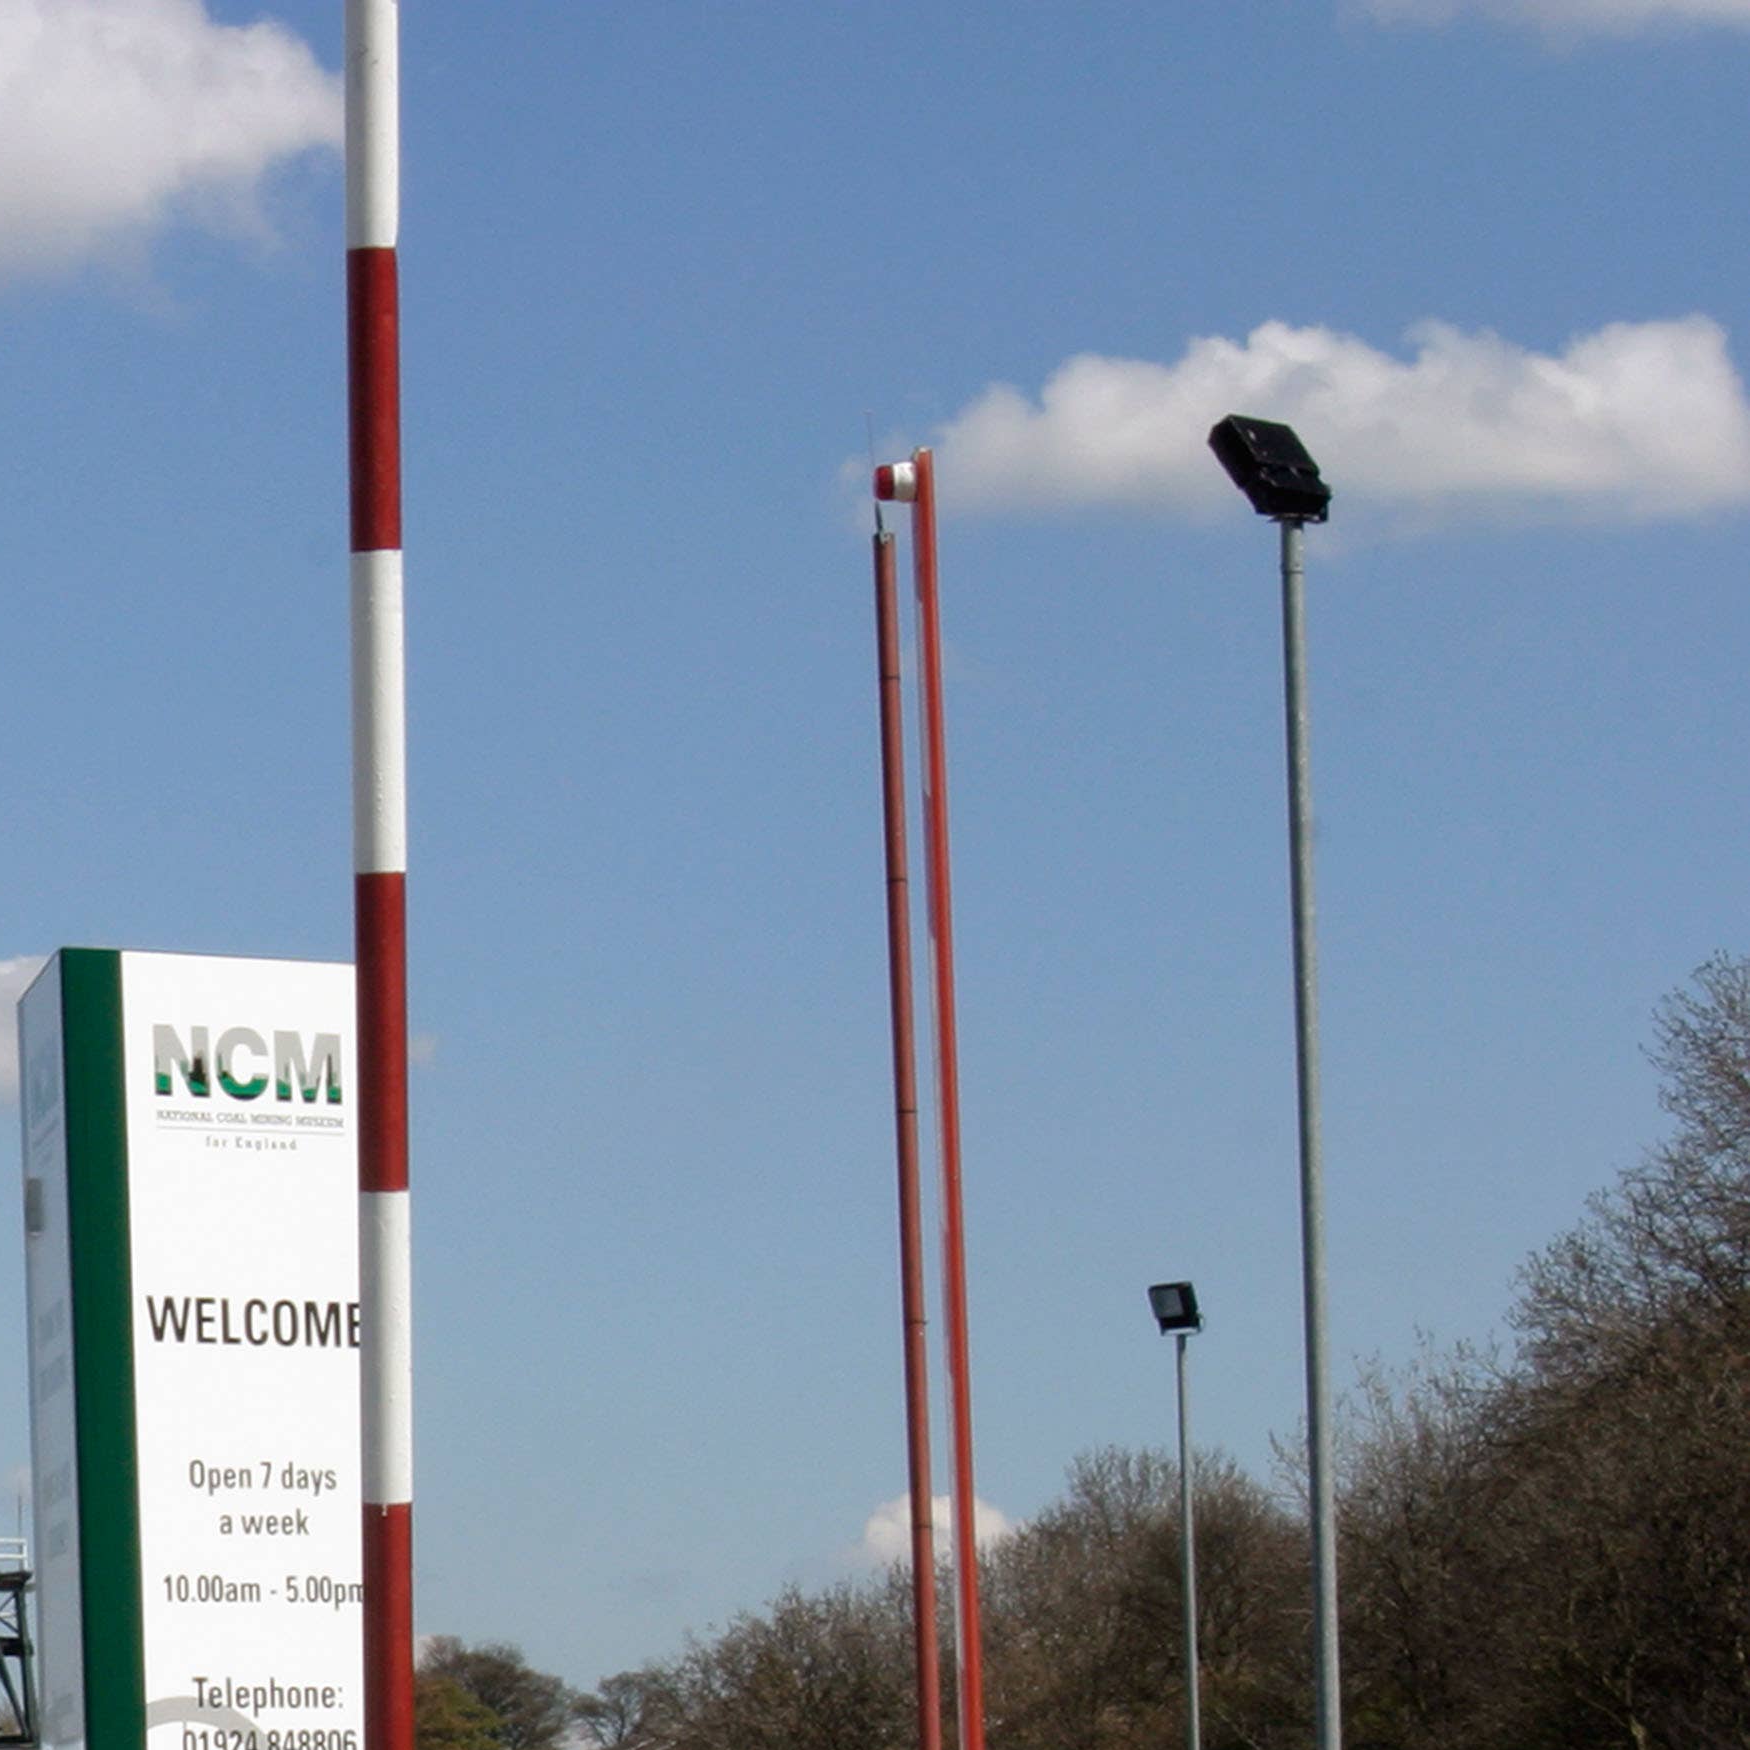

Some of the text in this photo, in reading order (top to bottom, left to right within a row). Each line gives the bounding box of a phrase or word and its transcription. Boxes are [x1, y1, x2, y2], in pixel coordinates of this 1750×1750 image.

[152, 1024, 342, 1105] NCM
[206, 1136, 298, 1152] for England
[147, 1296, 360, 1348] WELCOME
[190, 1459, 338, 1497] Open 7 days
[220, 1509, 311, 1537] a week
[163, 1575, 262, 1604] 10.00am
[286, 1576, 363, 1611] 5.00pm
[192, 1677, 344, 1716] Telephone:
